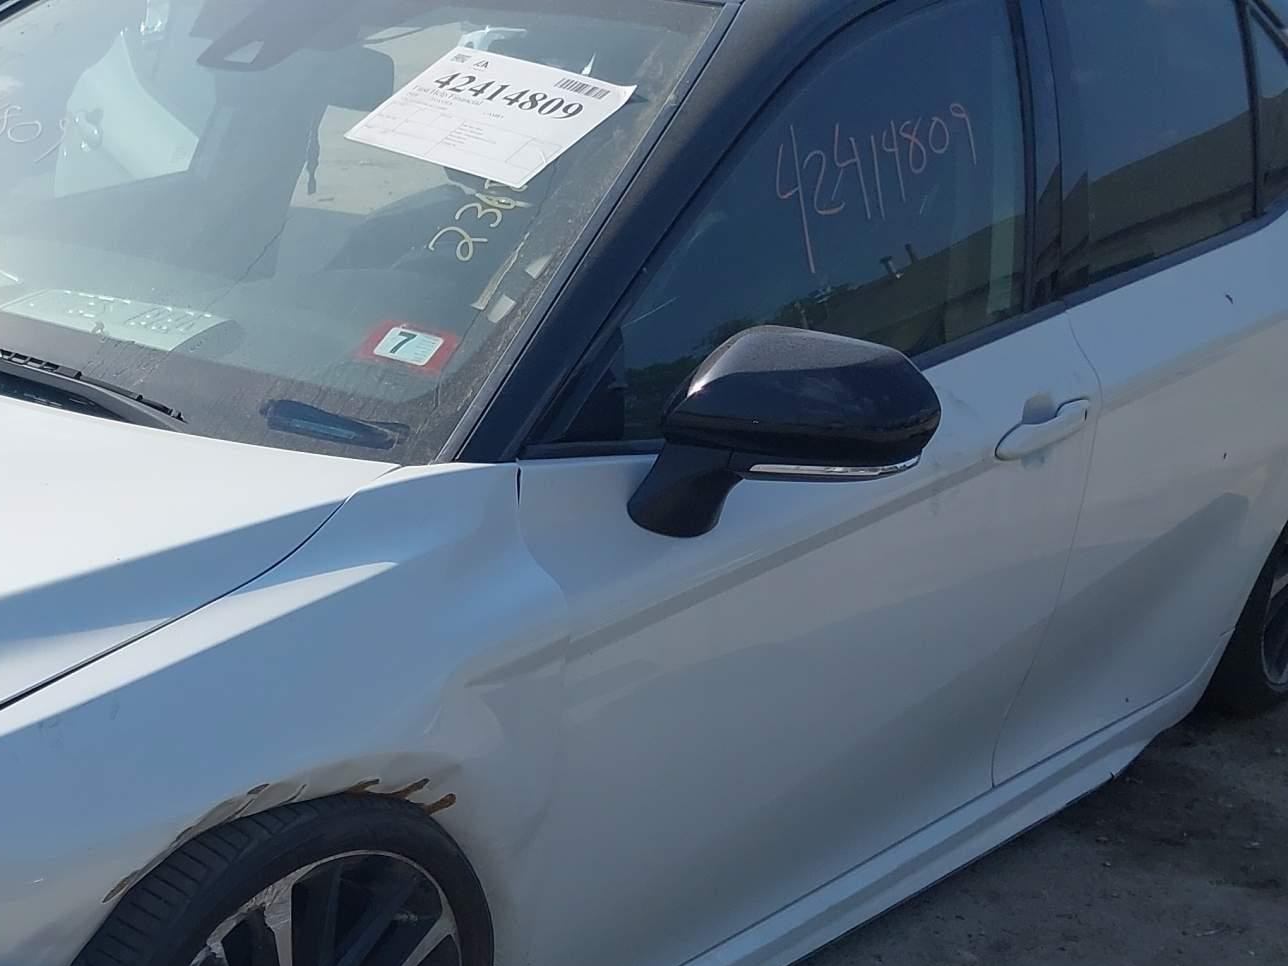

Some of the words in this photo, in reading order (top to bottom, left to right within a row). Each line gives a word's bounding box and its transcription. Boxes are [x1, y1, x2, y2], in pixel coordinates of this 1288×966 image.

[434, 72, 584, 120] 42414809
[776, 103, 976, 274] 42414809
[390, 331, 417, 354] 7
